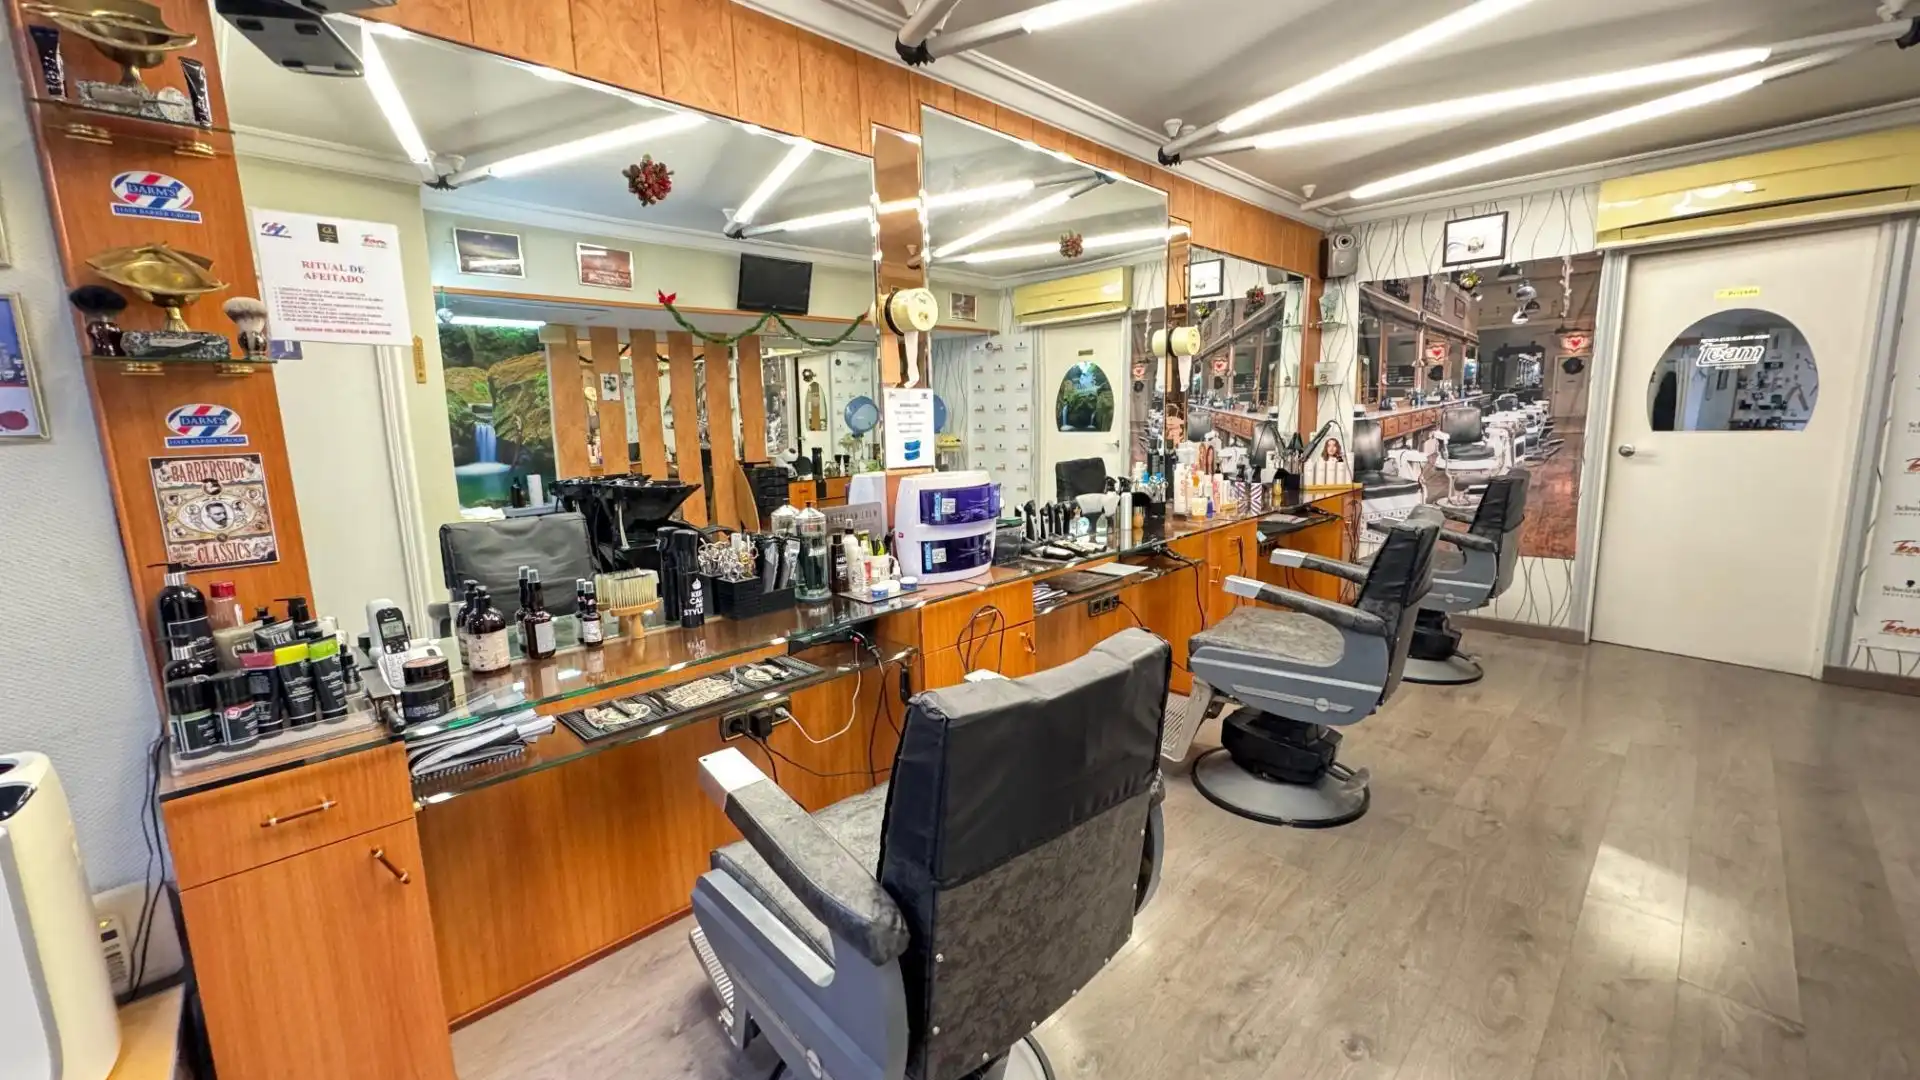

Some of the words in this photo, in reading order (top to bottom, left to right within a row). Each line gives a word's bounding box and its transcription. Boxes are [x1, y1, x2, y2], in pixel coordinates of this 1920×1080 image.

[301, 260, 347, 273] RITUAL
[349, 264, 366, 274] DE
[303, 272, 365, 284] AFEITADO
[181, 415, 226, 426] DARM'S
[171, 460, 247, 483] BARBERSHOP
[197, 542, 252, 564] CLASSICS
